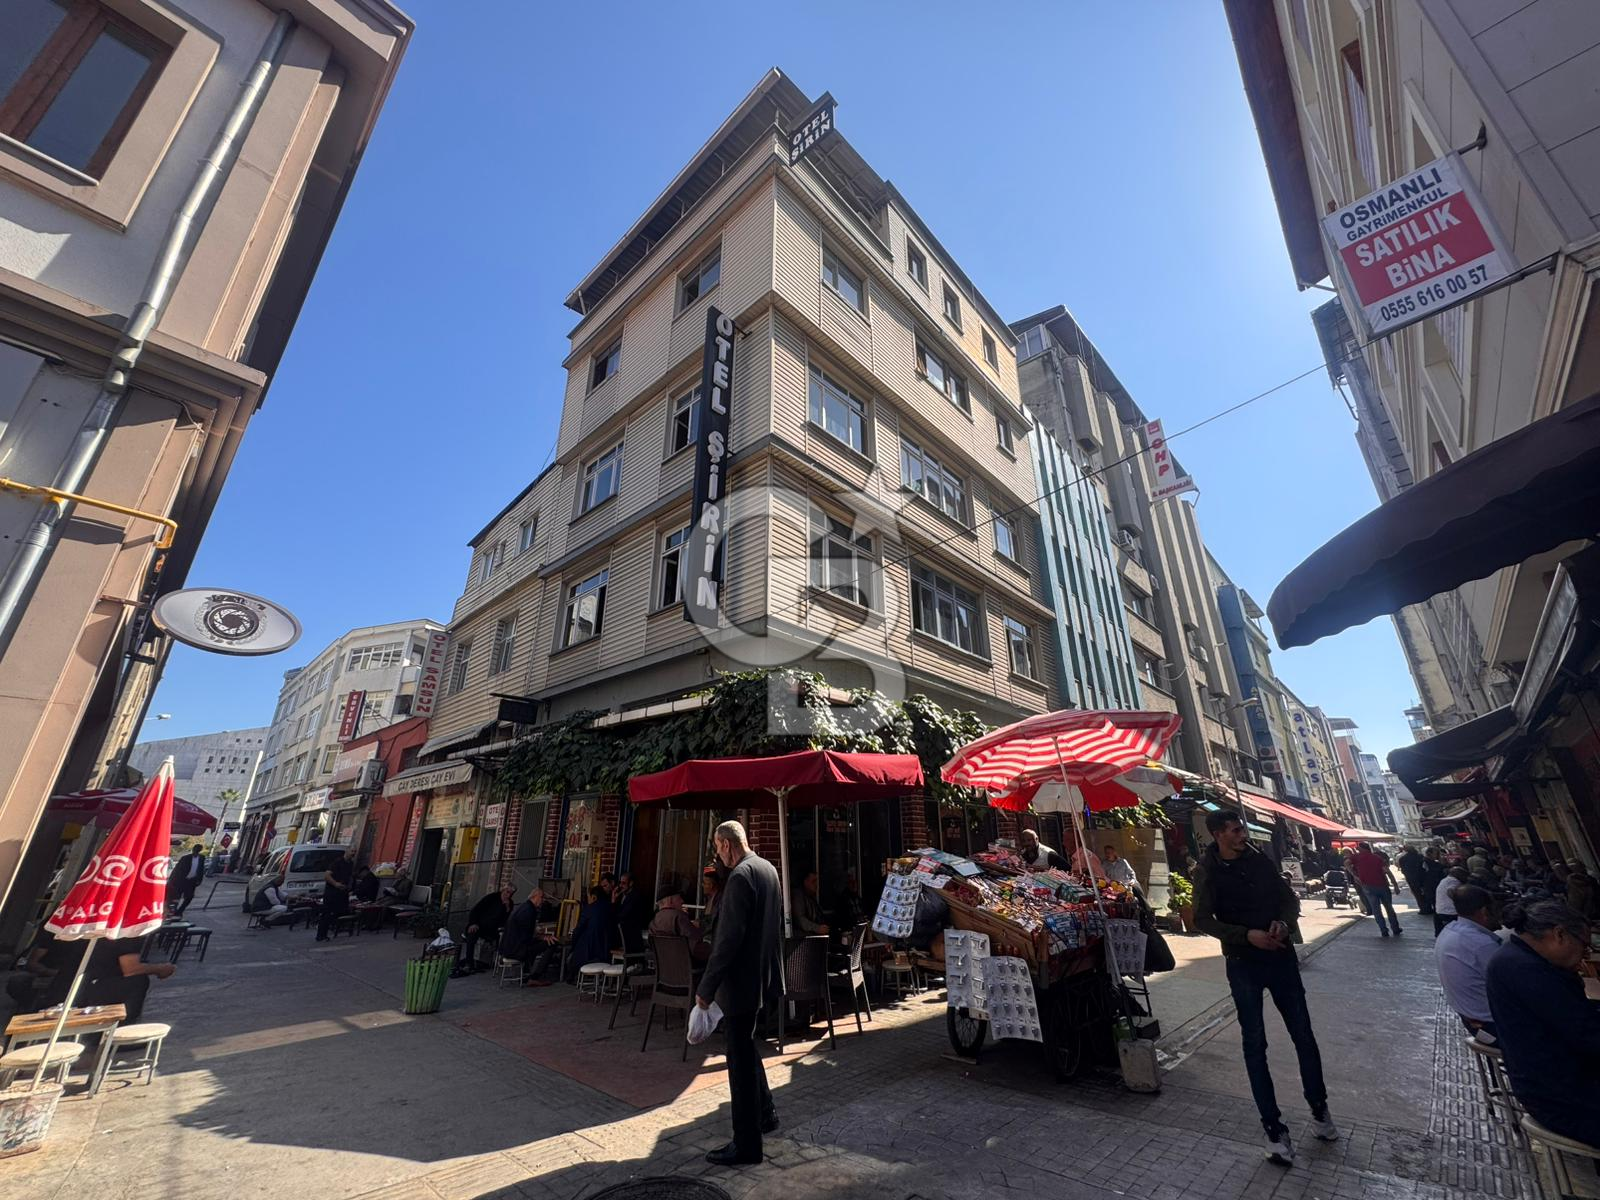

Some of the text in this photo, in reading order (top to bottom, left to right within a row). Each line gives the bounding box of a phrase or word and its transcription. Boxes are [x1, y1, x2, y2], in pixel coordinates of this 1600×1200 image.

[792, 110, 829, 146] OTEL
[1339, 167, 1443, 229] OSMANLI
[1355, 202, 1462, 268] SATILIK
[1380, 264, 1489, 322] 0555 616 00 57
[711, 313, 733, 416] OTEL
[416, 634, 448, 713] OTEL SAMSUN
